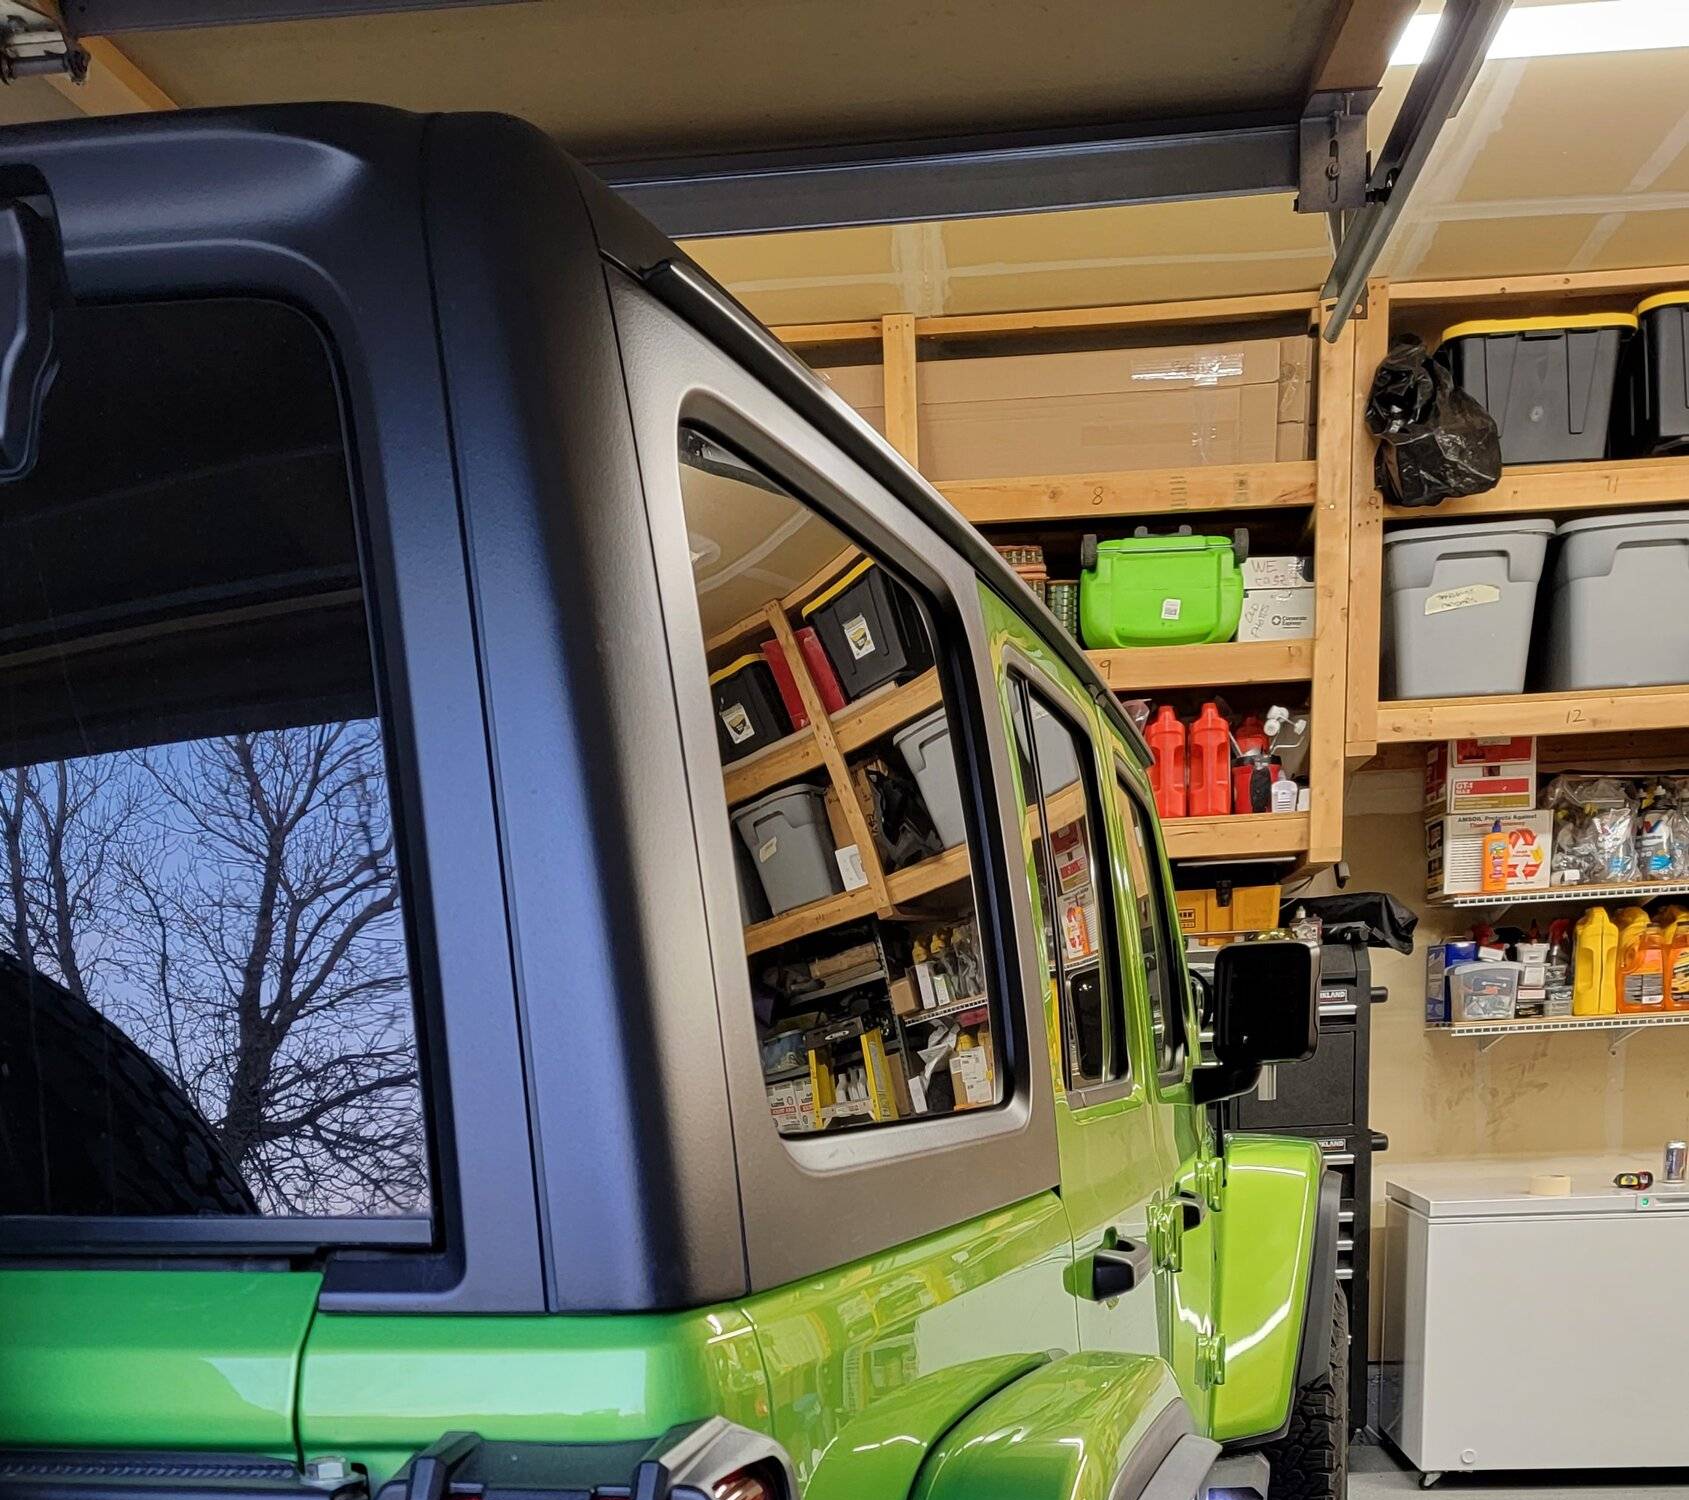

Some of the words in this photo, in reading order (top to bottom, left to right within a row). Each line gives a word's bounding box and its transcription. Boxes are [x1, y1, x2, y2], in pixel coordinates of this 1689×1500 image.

[1091, 486, 1104, 506] 8
[1099, 659, 1111, 680] 9
[1566, 709, 1586, 724] 12
